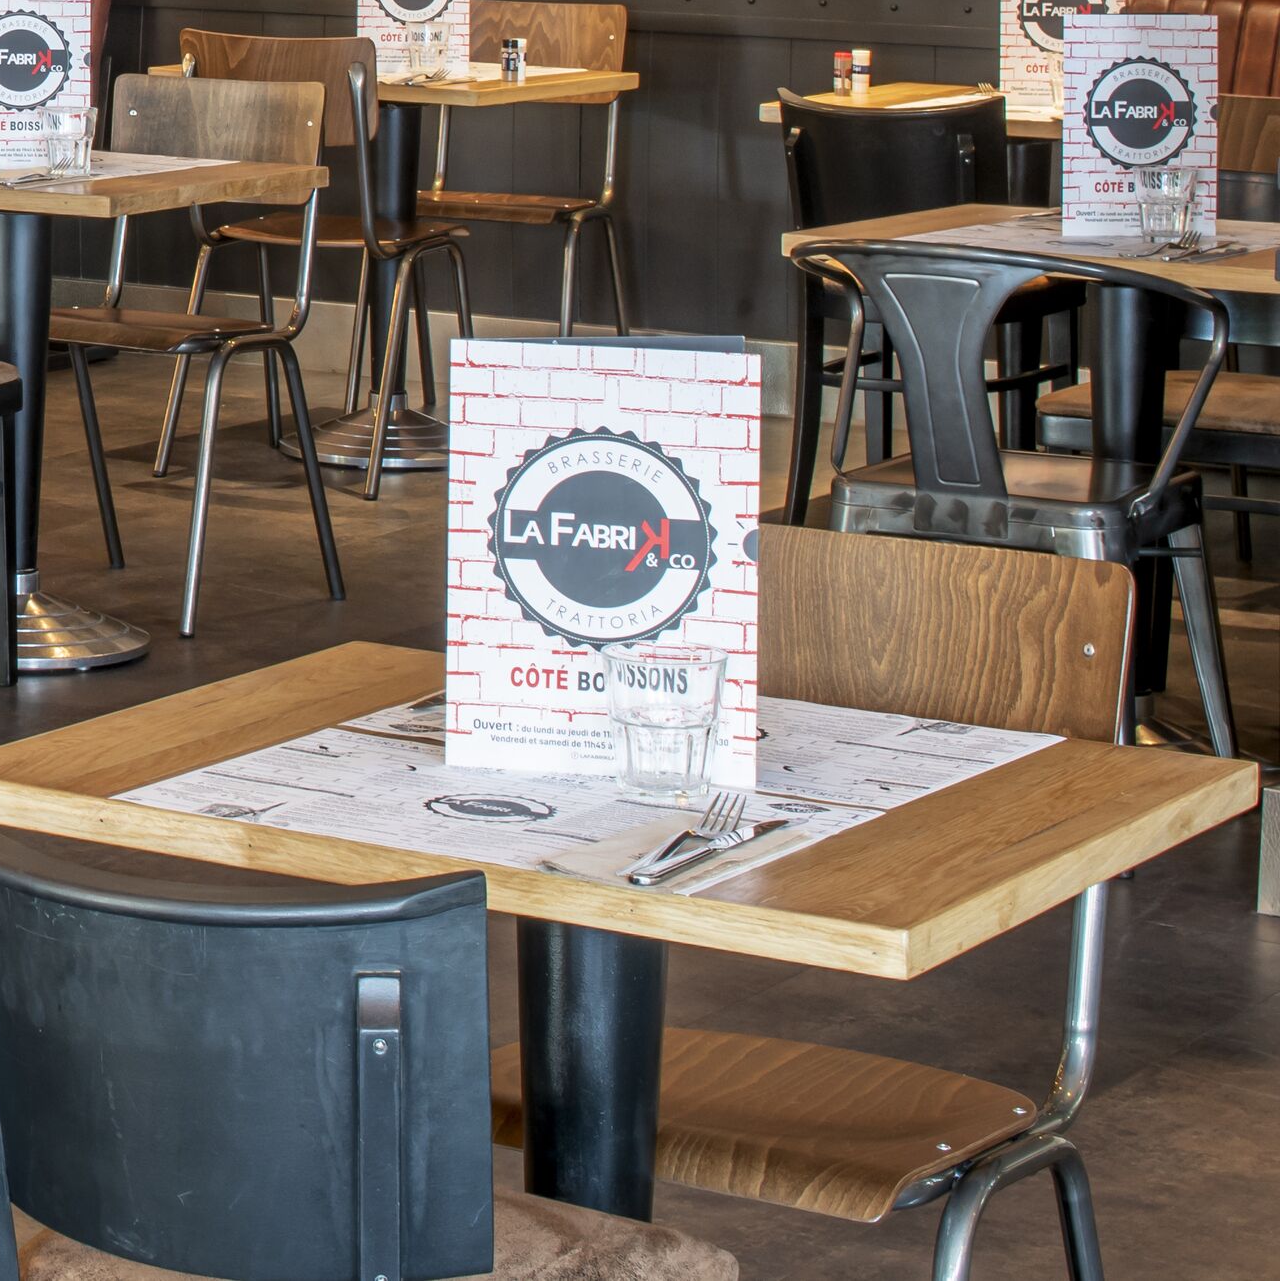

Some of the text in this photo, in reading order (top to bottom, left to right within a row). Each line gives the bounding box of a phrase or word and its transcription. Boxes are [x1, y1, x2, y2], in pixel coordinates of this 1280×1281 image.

[1023, 2, 1040, 17] LA
[50, 64, 63, 73] CO
[1113, 68, 1171, 85] BRASSERIE
[1091, 100, 1187, 130] LA FABRIK & CO
[1112, 145, 1171, 160] TRATTORIA
[1094, 179, 1124, 193] CÔTÉ
[547, 450, 665, 485] BRASSERIE
[503, 508, 696, 572] LA FABRIK & CO
[546, 598, 664, 630] TRATTORIA
[510, 662, 569, 691] CÔTÉ
[472, 717, 513, 732] Ouvert
[521, 724, 532, 733] du
[533, 724, 555, 735] lundi
[556, 727, 567, 735] au
[567, 727, 589, 738] jeudi
[590, 728, 602, 738] de
[490, 733, 527, 745] Vendredi
[528, 736, 537, 745] et
[539, 737, 570, 748] samedi
[571, 739, 582, 748] de
[583, 739, 606, 750] 11h45
